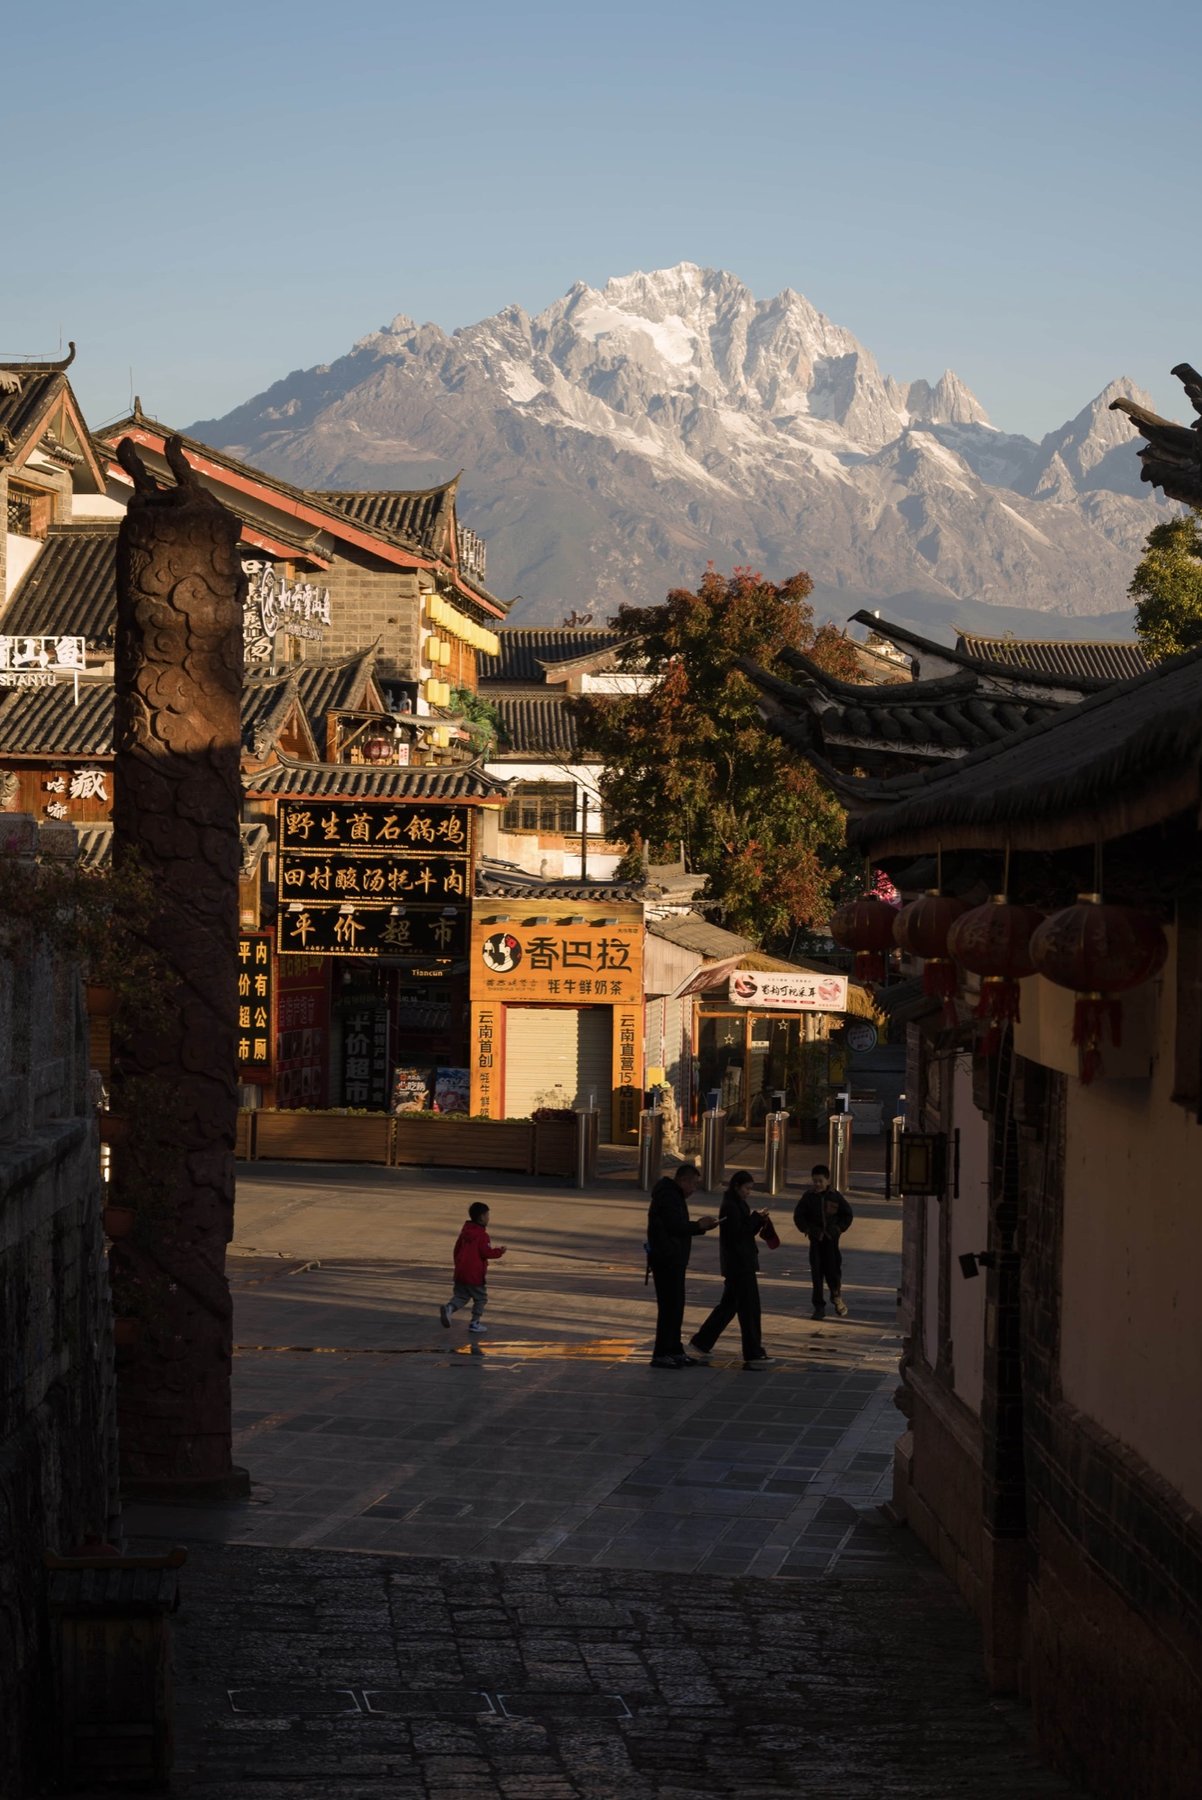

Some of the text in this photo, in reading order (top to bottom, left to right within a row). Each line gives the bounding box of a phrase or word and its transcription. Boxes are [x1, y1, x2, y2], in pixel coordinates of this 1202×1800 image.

[286, 811, 465, 844] 野生菌石锅鸡
[284, 865, 463, 895] 田村酸汤牦牛肉
[290, 913, 457, 949] 平价超市
[412, 969, 443, 977] Tiancun
[525, 937, 632, 973] 香巴拉
[238, 941, 251, 1061] 平价超市
[254, 941, 268, 1061] 内有公厕
[548, 979, 623, 995] 牦牛鲜奶茶
[478, 1010, 493, 1068] 云南首创
